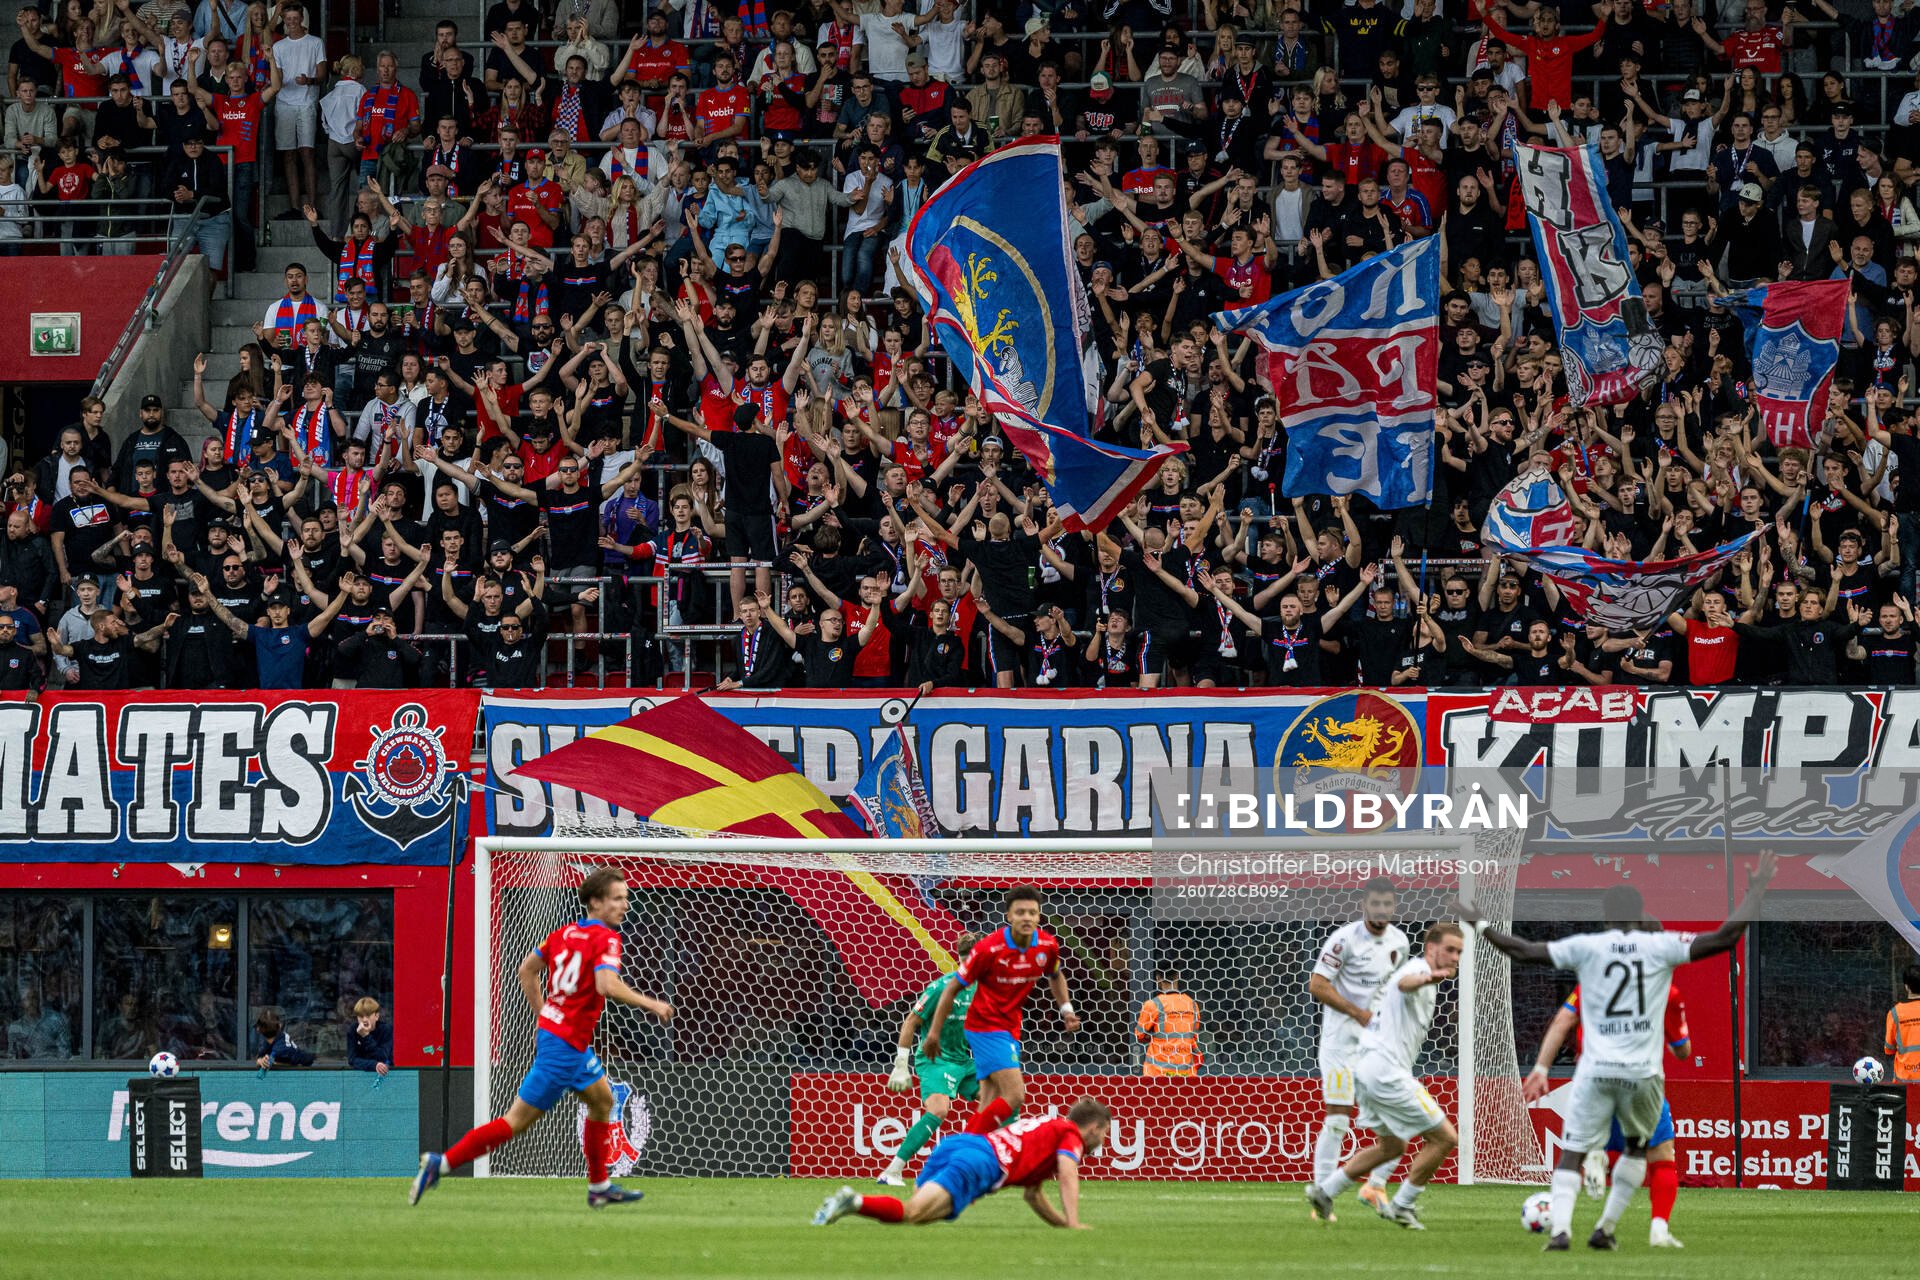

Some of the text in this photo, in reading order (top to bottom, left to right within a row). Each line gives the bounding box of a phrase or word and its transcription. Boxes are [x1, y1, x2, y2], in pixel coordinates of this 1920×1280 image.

[358, 354, 388, 366] Emirates
[1492, 687, 1634, 721] ACAB
[380, 735, 432, 757] CREWMATES
[377, 771, 433, 796] HELSINGBORG
[552, 949, 582, 996] 14
[1604, 960, 1646, 1018] 21
[135, 1100, 146, 1170] SELECT
[169, 1100, 188, 1170] SELECT
[1672, 1118, 1790, 1140] nssons
[1836, 1105, 1852, 1178] SELECT
[1875, 1107, 1894, 1180] SELECT
[1686, 1150, 1828, 1185] Helsingb
